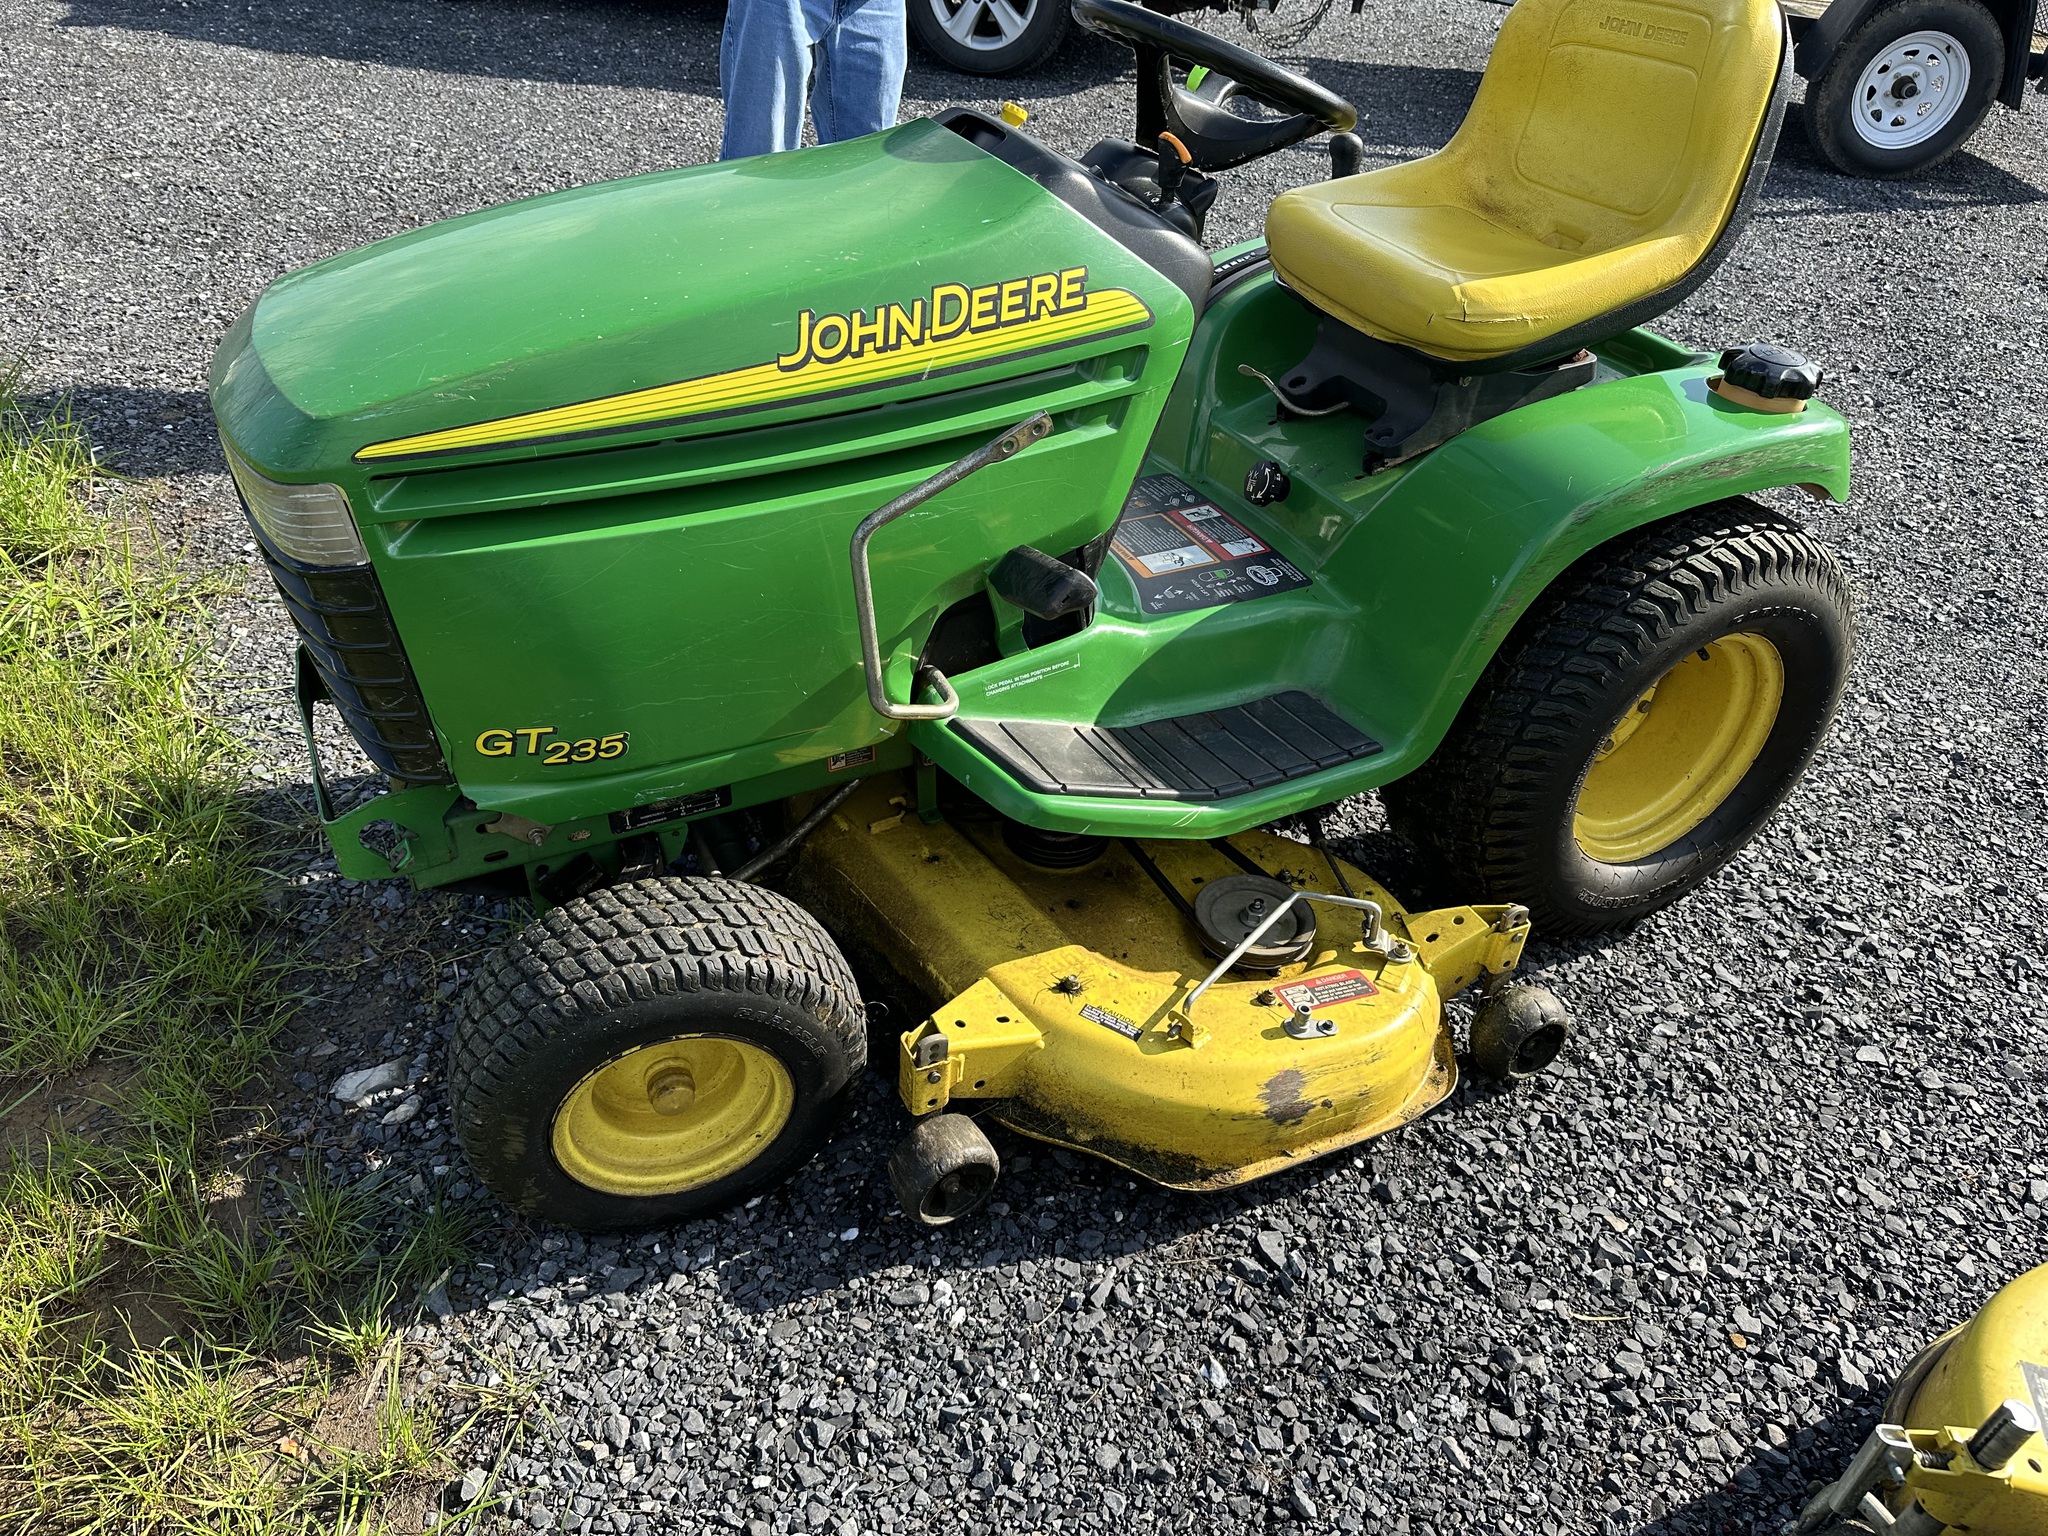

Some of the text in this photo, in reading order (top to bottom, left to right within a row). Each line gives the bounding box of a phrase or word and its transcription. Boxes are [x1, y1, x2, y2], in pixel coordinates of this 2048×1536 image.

[1599, 16, 1689, 47] JOHN DEERE
[777, 265, 1089, 372] JOHN DEERE
[985, 683, 998, 691] LOCK
[999, 679, 1013, 687] PEDAL
[1020, 672, 1030, 680] THIS
[1030, 666, 1051, 676] POSITION
[1052, 660, 1069, 670] BEFORE
[985, 675, 1043, 696] CHANGING ATTACHMENTS
[1577, 888, 1639, 909] MASTER
[1315, 983, 1339, 991] ROTATING
[1321, 973, 1348, 982] DANGER
[1102, 1006, 1137, 1025] CAUTION
